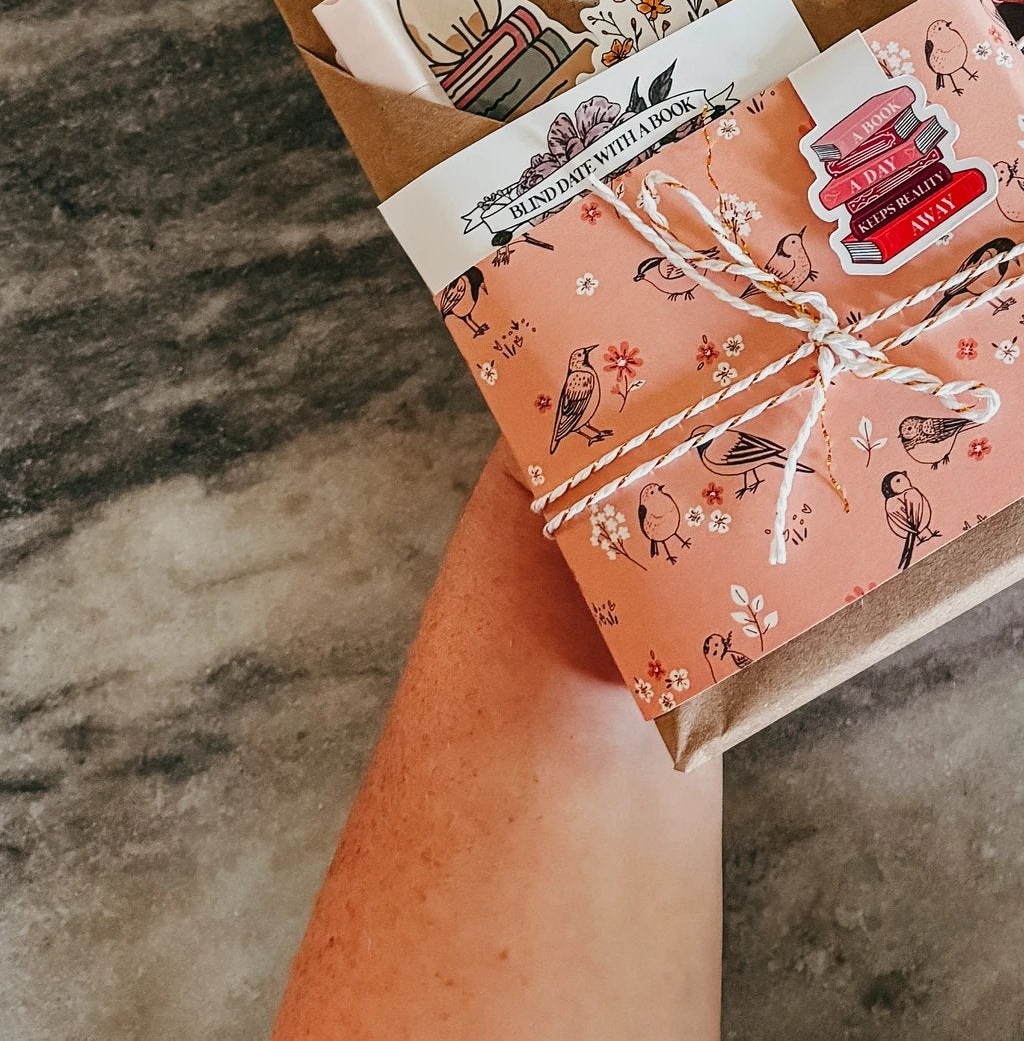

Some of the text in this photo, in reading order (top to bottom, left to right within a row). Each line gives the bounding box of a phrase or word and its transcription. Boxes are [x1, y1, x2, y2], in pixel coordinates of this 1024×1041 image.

[851, 99, 902, 146] A BOOK
[509, 96, 698, 220] BLIND DATE WITH A BOOK
[849, 157, 899, 195] A DAY
[858, 170, 946, 234] KEEPS REALITY
[909, 194, 956, 237] AWAY
